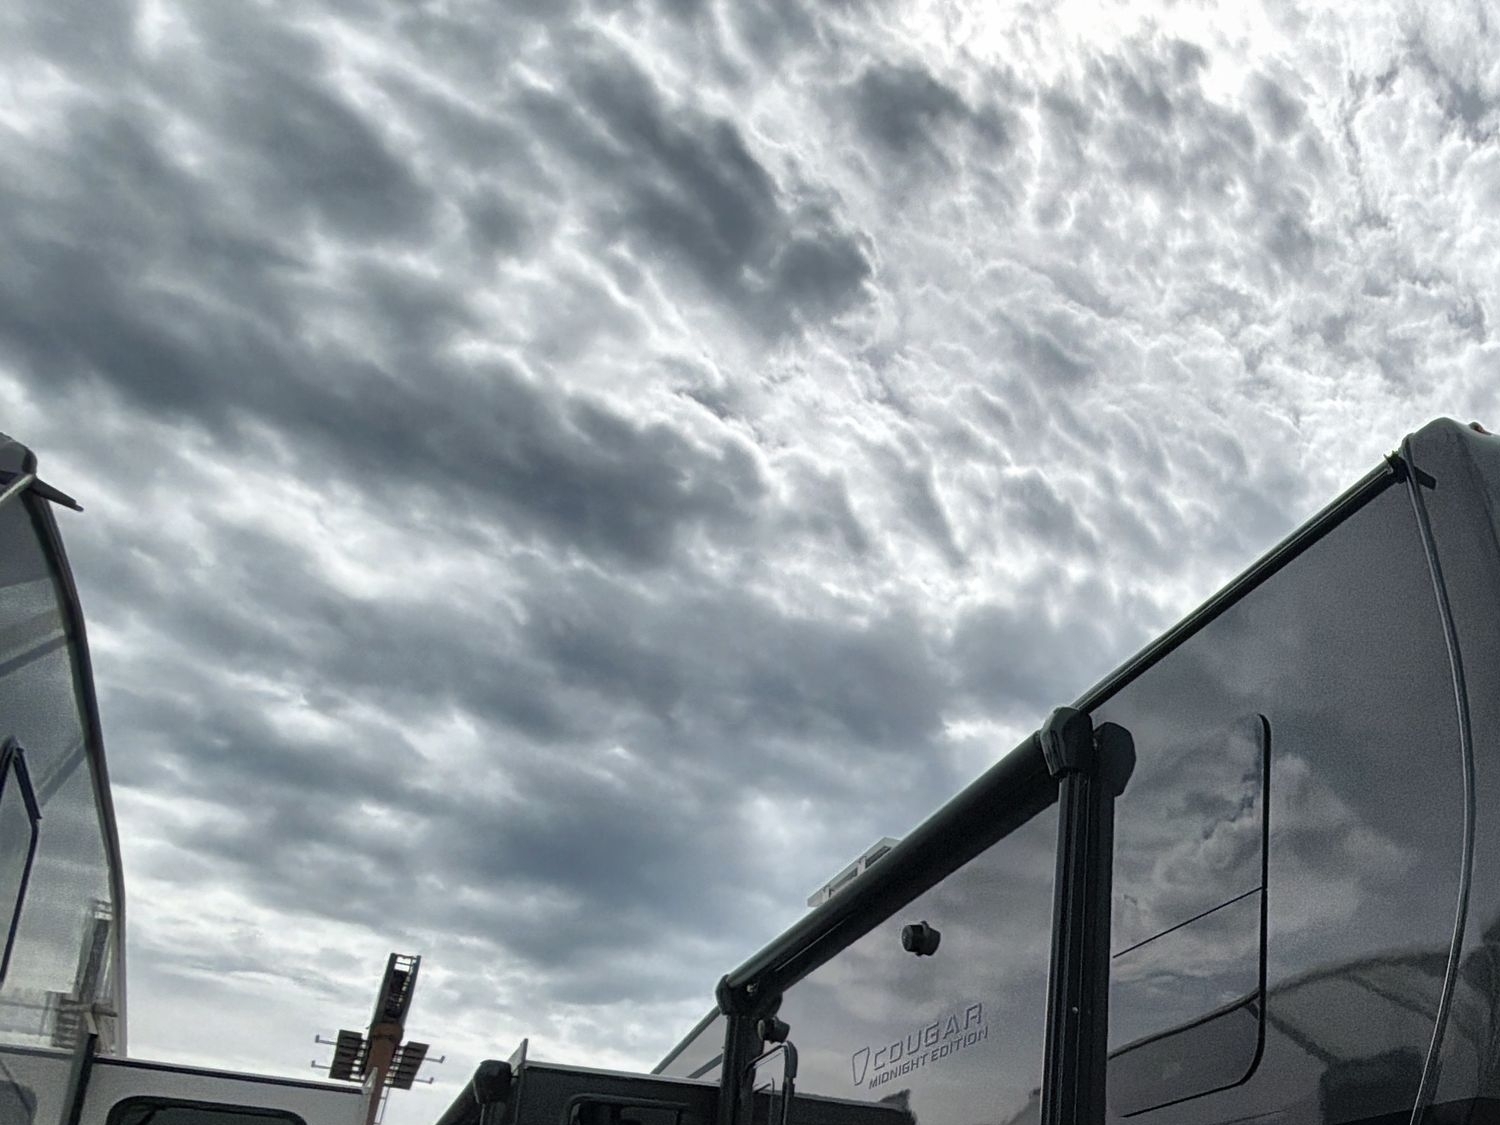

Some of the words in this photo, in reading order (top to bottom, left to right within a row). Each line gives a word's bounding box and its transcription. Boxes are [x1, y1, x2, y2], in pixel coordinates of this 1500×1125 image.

[868, 1052, 929, 1090] MIDNIGHT
[930, 1026, 989, 1062] EDITION
[873, 1002, 982, 1071] COUGAR
